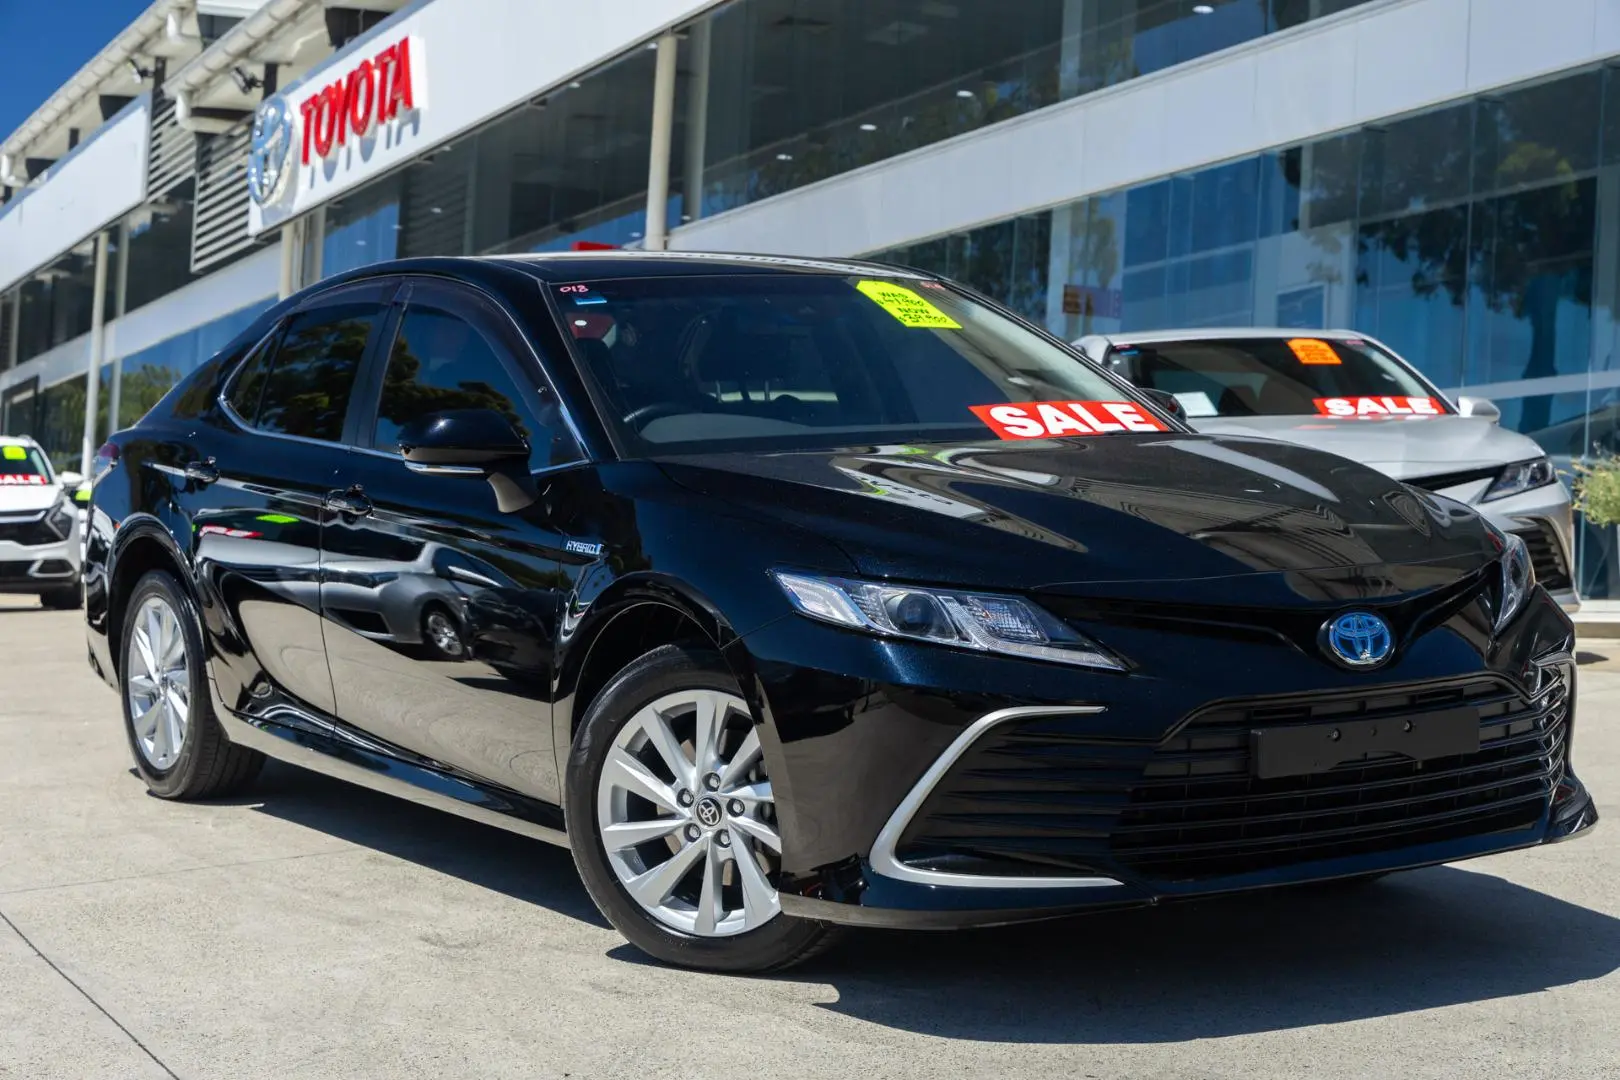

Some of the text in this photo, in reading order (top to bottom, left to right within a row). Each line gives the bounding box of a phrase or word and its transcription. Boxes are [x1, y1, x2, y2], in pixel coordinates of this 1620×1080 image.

[300, 36, 413, 165] TOYOTA
[1324, 397, 1439, 415] SALE
[989, 403, 1156, 437] SALE
[0, 474, 42, 485] ALE
[566, 540, 596, 554] HYBRID
